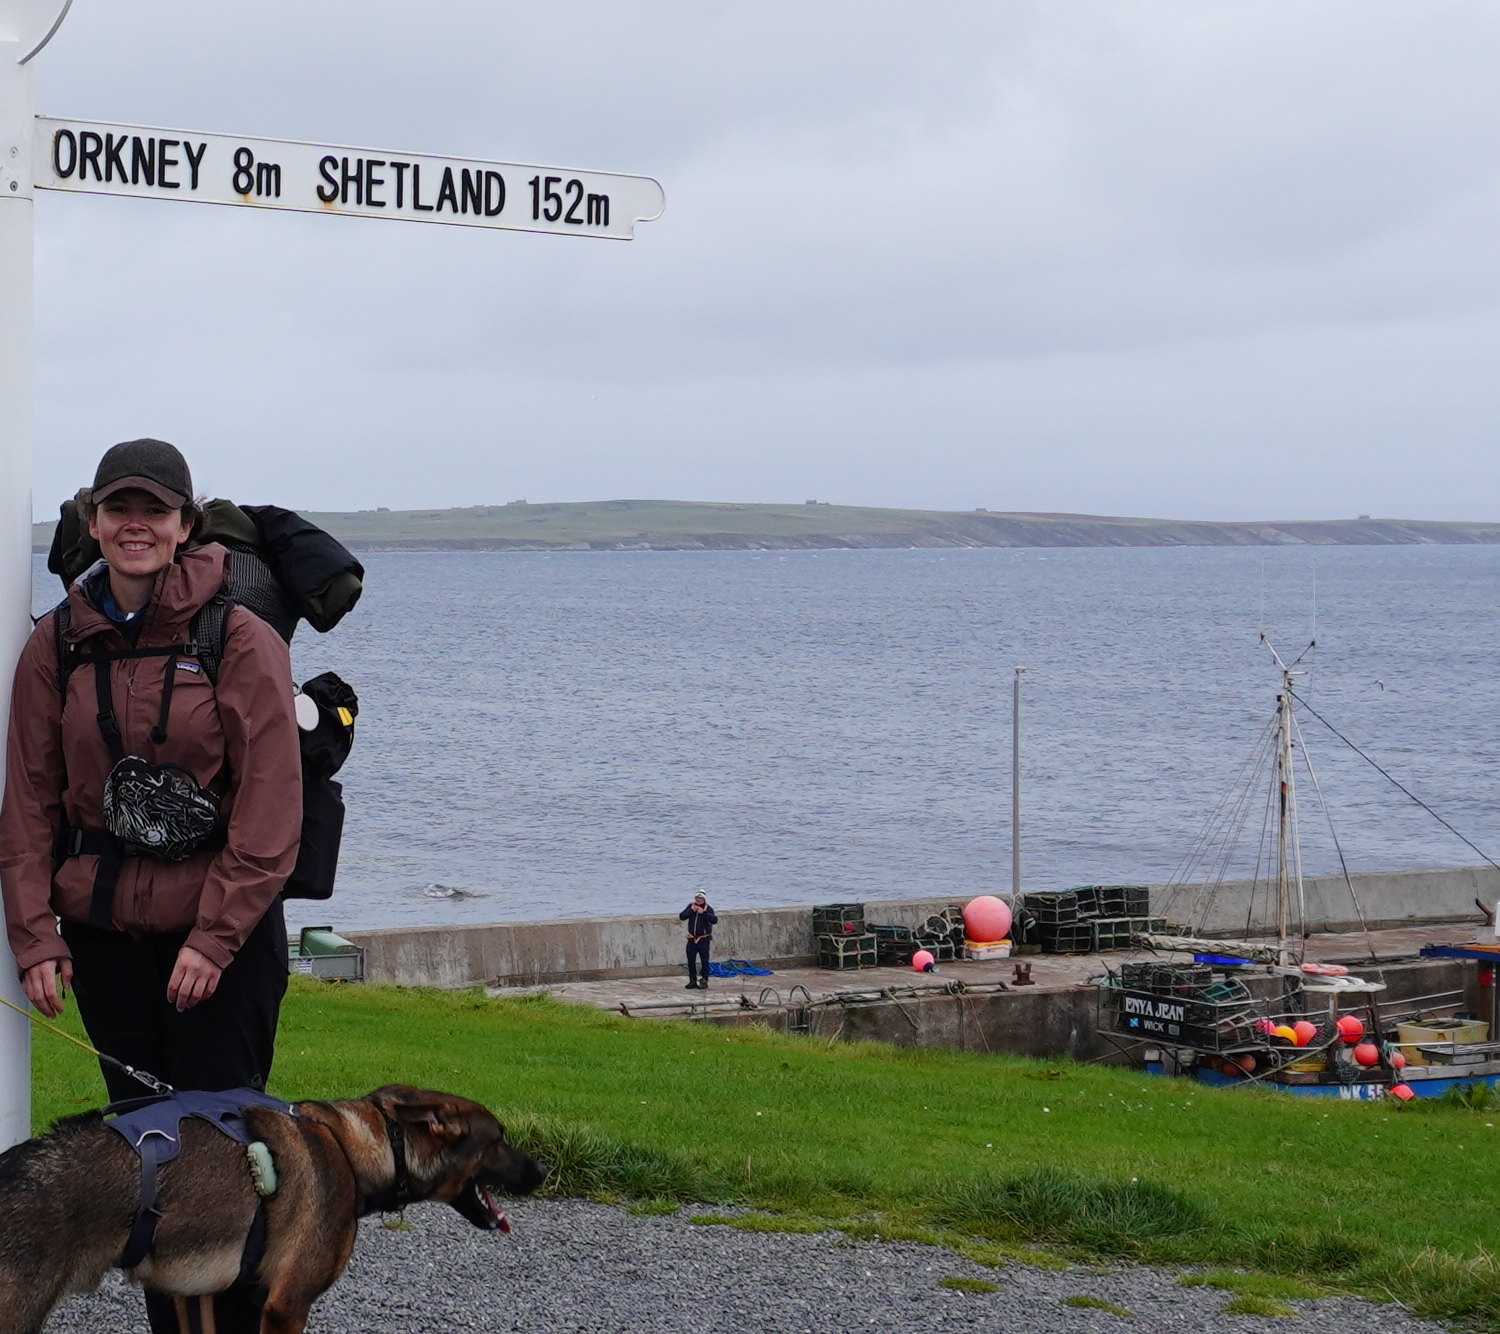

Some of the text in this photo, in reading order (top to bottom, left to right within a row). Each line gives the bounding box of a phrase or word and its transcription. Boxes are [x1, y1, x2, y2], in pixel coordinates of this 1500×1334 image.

[53, 129, 610, 227] ORKNEY 8m SHETLAND 152m
[1125, 997, 1184, 1022] ENYA JEAN
[1143, 1019, 1164, 1033] WICK
[1340, 1084, 1361, 1100] WK
